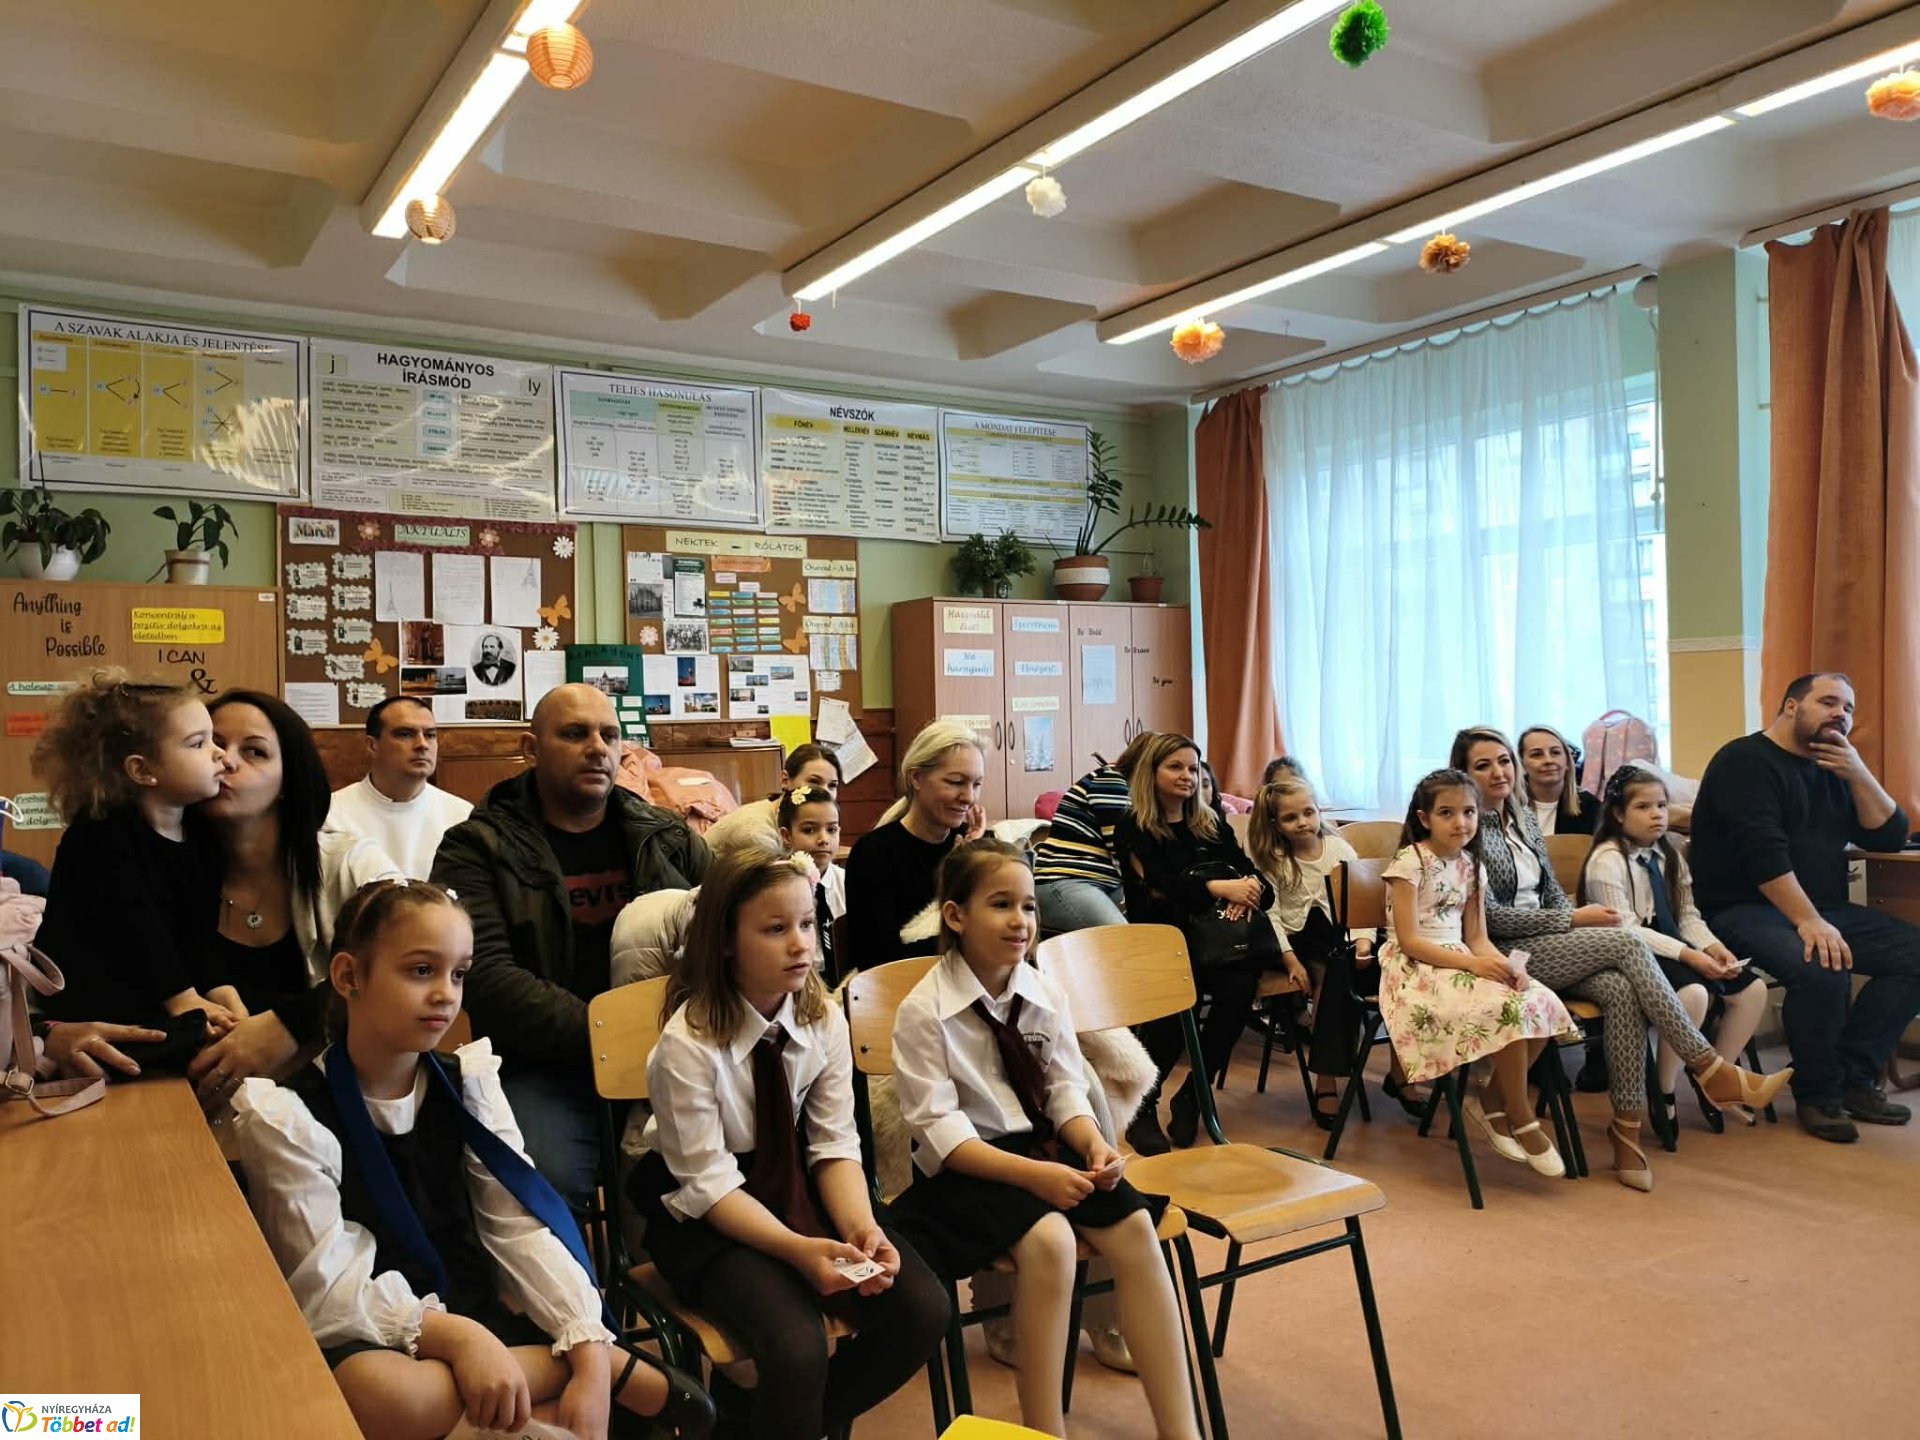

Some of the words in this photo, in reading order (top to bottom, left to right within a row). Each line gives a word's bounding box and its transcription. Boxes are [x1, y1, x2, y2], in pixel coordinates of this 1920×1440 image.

[54, 321, 65, 332] A
[68, 322, 123, 340] SZAVAK
[127, 329, 181, 346] ALAKJA
[183, 332, 199, 347] ÉS
[201, 336, 273, 353] JELENTÉSE
[329, 354, 335, 374] j
[377, 352, 495, 377] HAGYOMÁNYOS
[402, 369, 472, 390] ÍRÁSMÓD
[528, 377, 541, 396] ly
[609, 383, 646, 397] TELJES
[829, 404, 876, 422] NÉVSZÓK
[675, 536, 718, 548] NEKTEK
[13, 592, 82, 616] Anything
[60, 618, 73, 634] is
[45, 636, 106, 657] Possible
[167, 650, 205, 664] CAN
